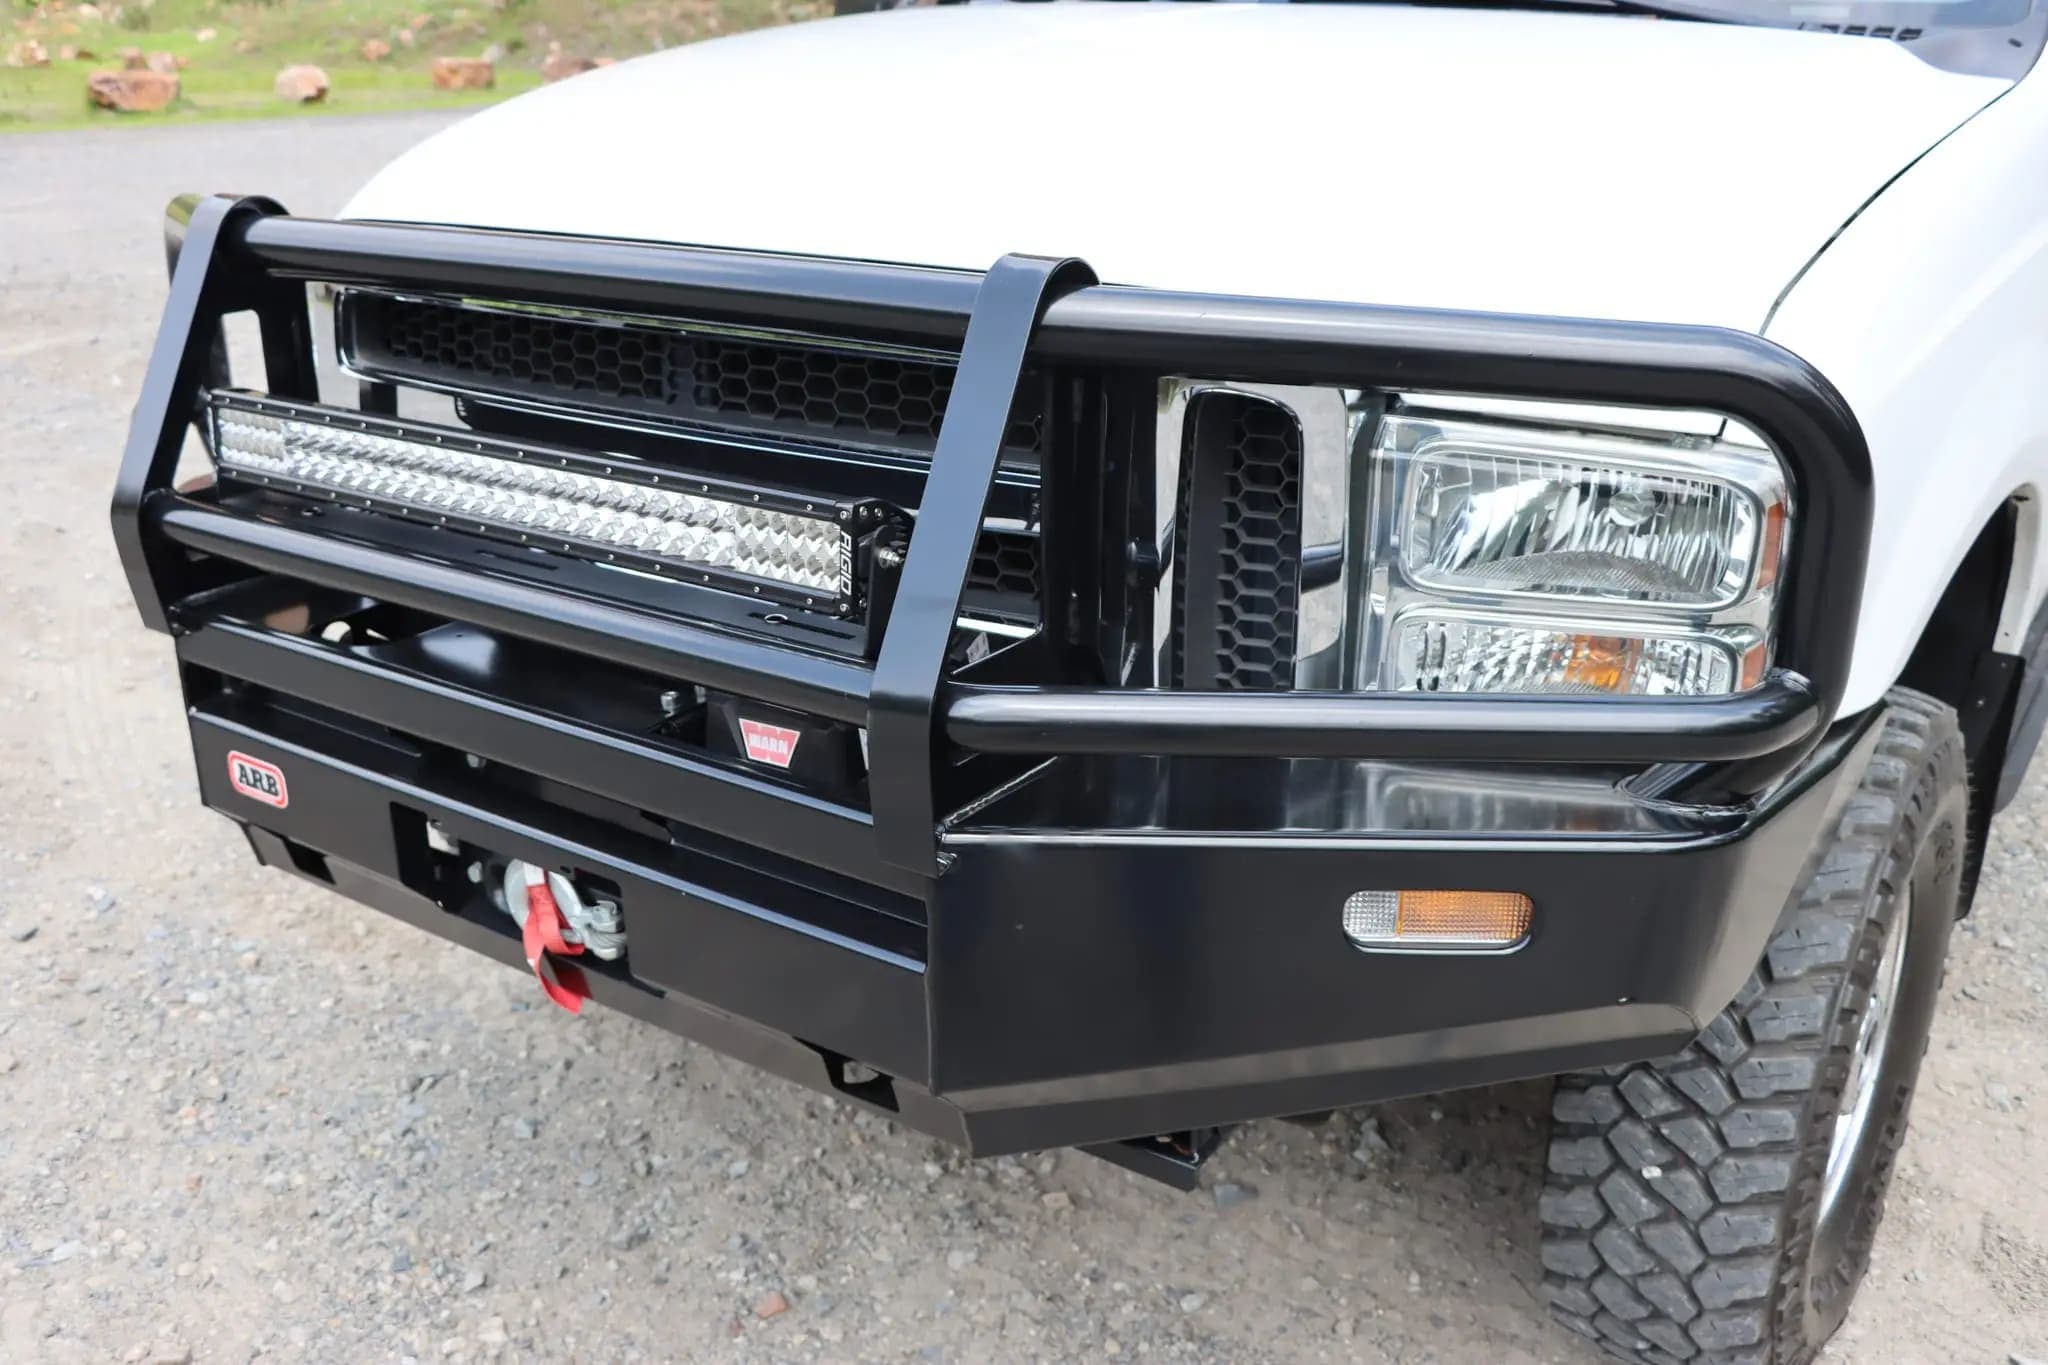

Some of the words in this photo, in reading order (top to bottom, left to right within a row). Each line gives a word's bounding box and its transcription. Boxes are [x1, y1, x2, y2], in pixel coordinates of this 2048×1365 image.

[840, 530, 852, 596] RIGID
[748, 732, 788, 755] WARN
[237, 762, 279, 797] ARB
